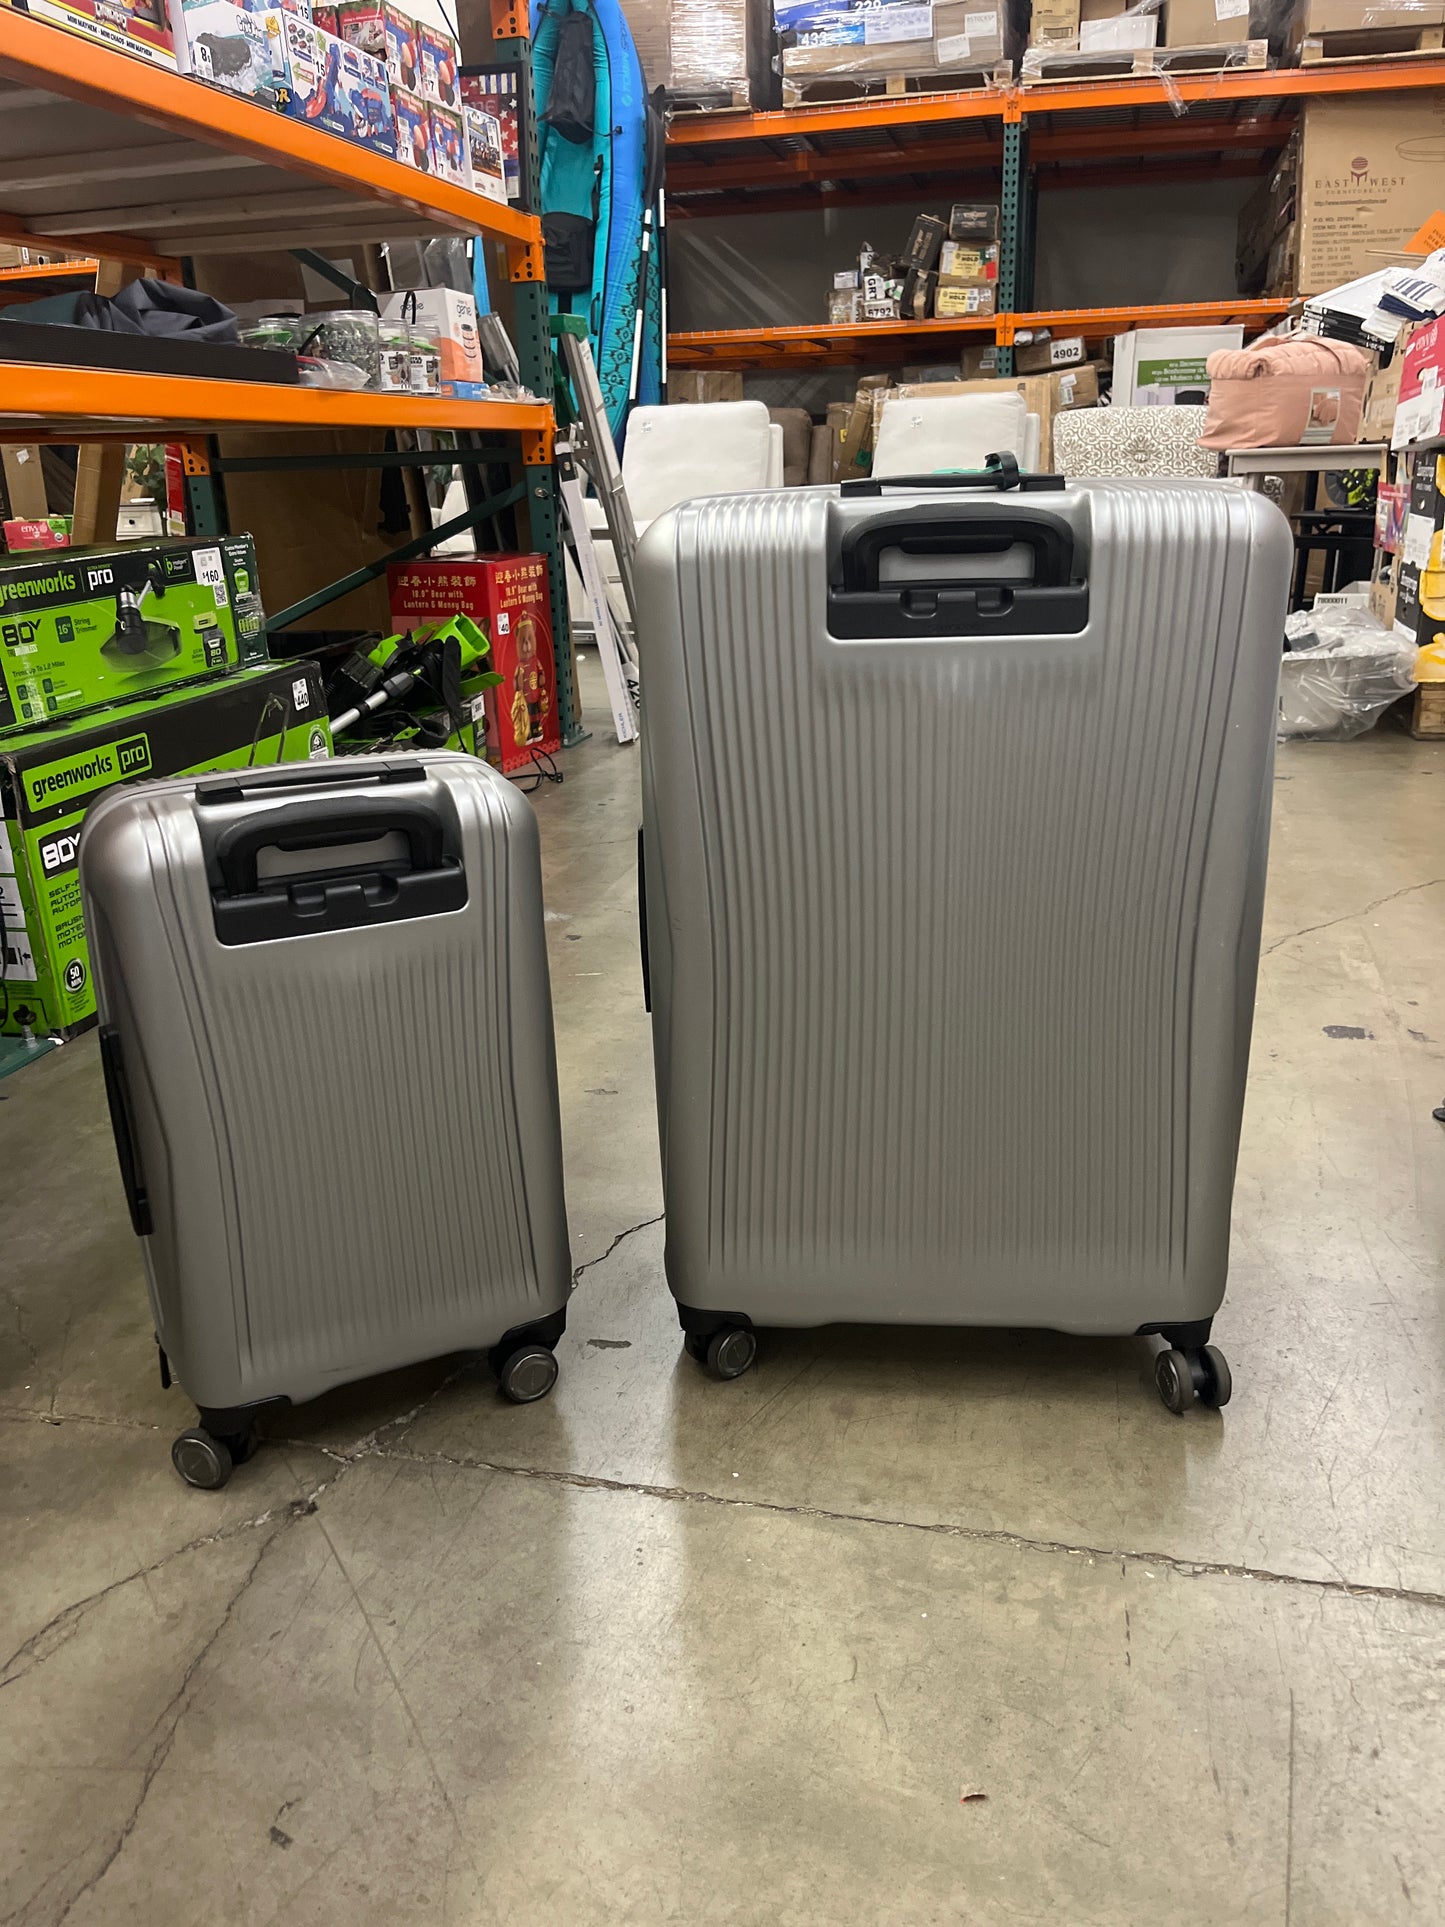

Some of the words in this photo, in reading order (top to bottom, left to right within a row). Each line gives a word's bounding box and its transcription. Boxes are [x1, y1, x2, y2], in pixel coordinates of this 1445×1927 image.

[1315, 178, 1348, 189] EAST
[1370, 176, 1406, 187] WEST
[1053, 347, 1080, 360] 4902
[21, 525, 39, 534] envy
[87, 568, 114, 591] pro
[202, 569, 219, 583] $160
[431, 589, 446, 599] Bear
[447, 589, 464, 599] with
[403, 600, 429, 609] Lantern
[437, 600, 460, 611] Money
[461, 600, 474, 611] Bag
[32, 754, 114, 804] greenworks
[120, 745, 146, 771] pro
[42, 832, 82, 871] 80V
[70, 965, 80, 980] 50
